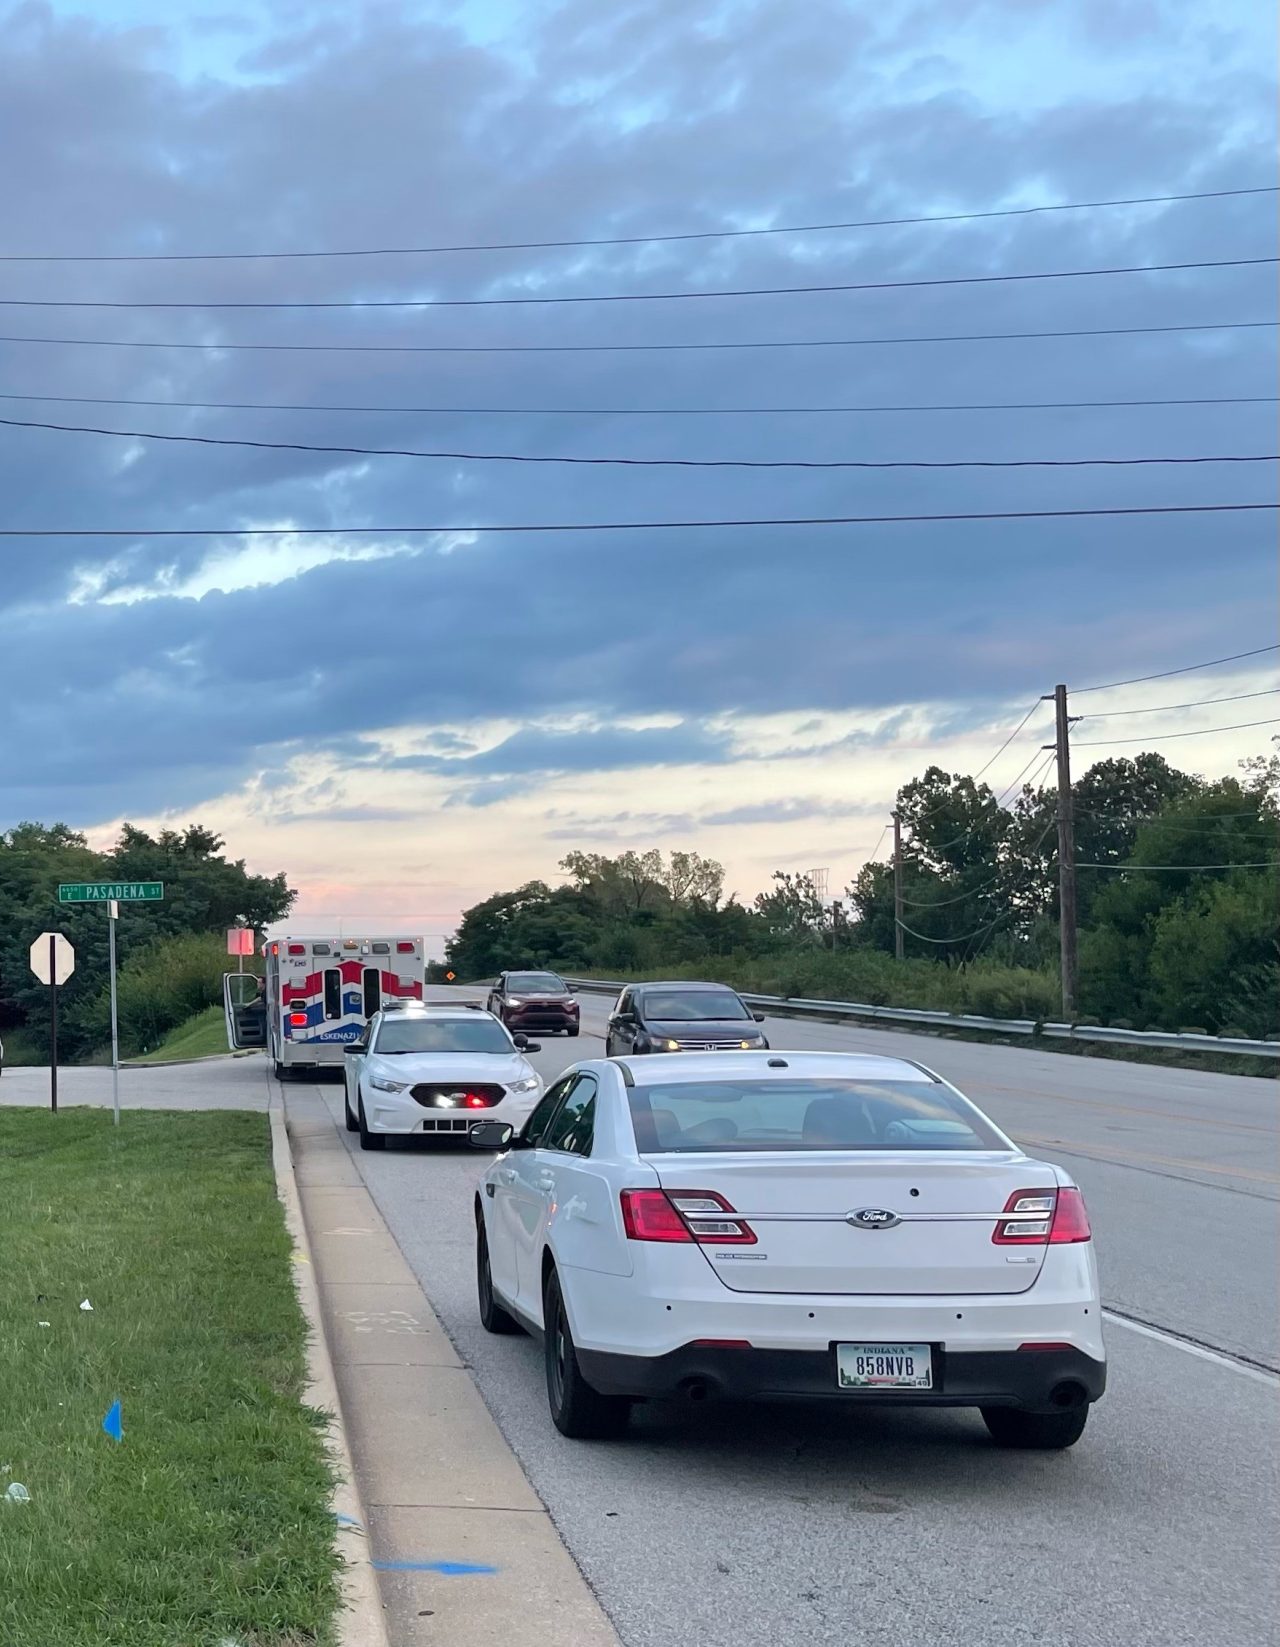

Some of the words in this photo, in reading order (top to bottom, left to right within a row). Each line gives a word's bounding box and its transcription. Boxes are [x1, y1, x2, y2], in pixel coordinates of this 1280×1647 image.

[67, 892, 73, 900] E
[86, 885, 145, 899] PASADENA
[151, 887, 160, 896] ST
[320, 1031, 356, 1041] ESKENAZI
[862, 1210, 888, 1221] Ford
[863, 1346, 905, 1355] INDIANA
[856, 1356, 914, 1376] 858NVB
